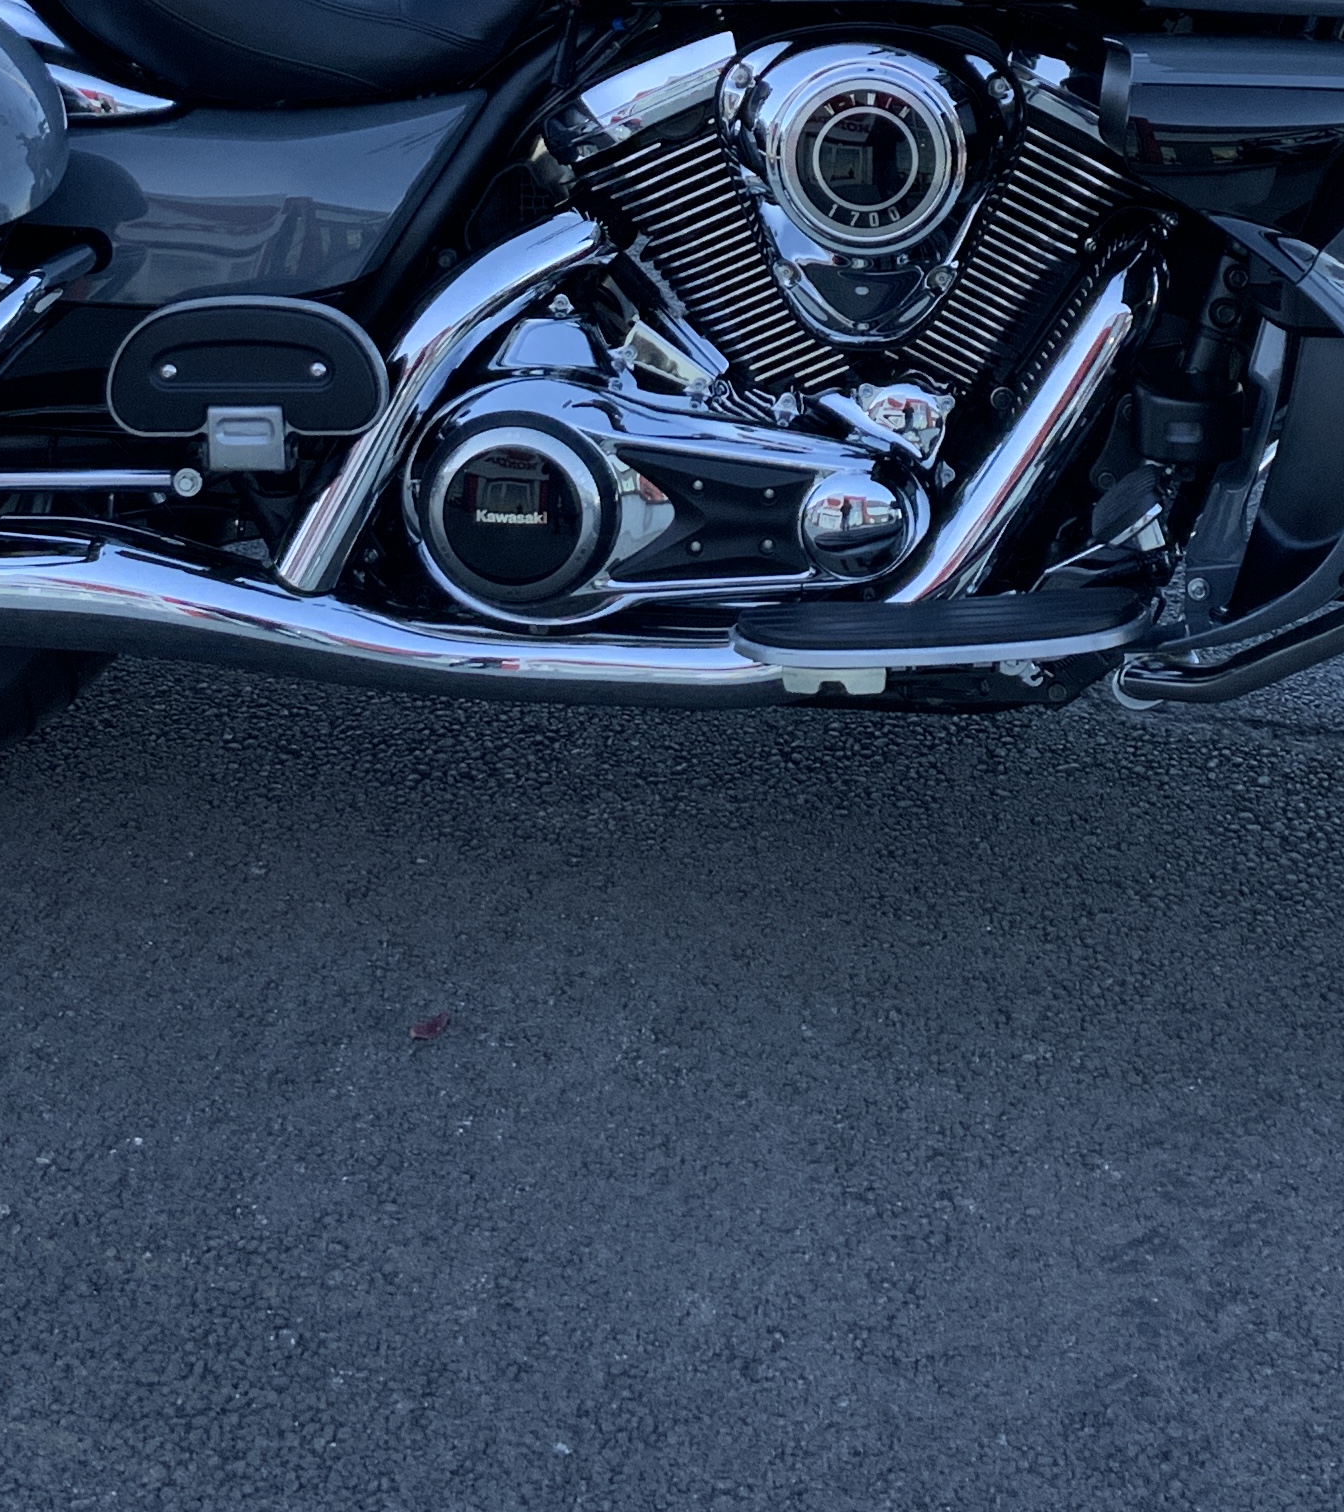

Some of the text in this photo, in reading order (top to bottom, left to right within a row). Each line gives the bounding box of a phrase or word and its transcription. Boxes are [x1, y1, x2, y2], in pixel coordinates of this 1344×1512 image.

[823, 91, 912, 119] V-TWIN
[827, 204, 901, 228] 1700
[476, 509, 548, 524] Kawasaki
